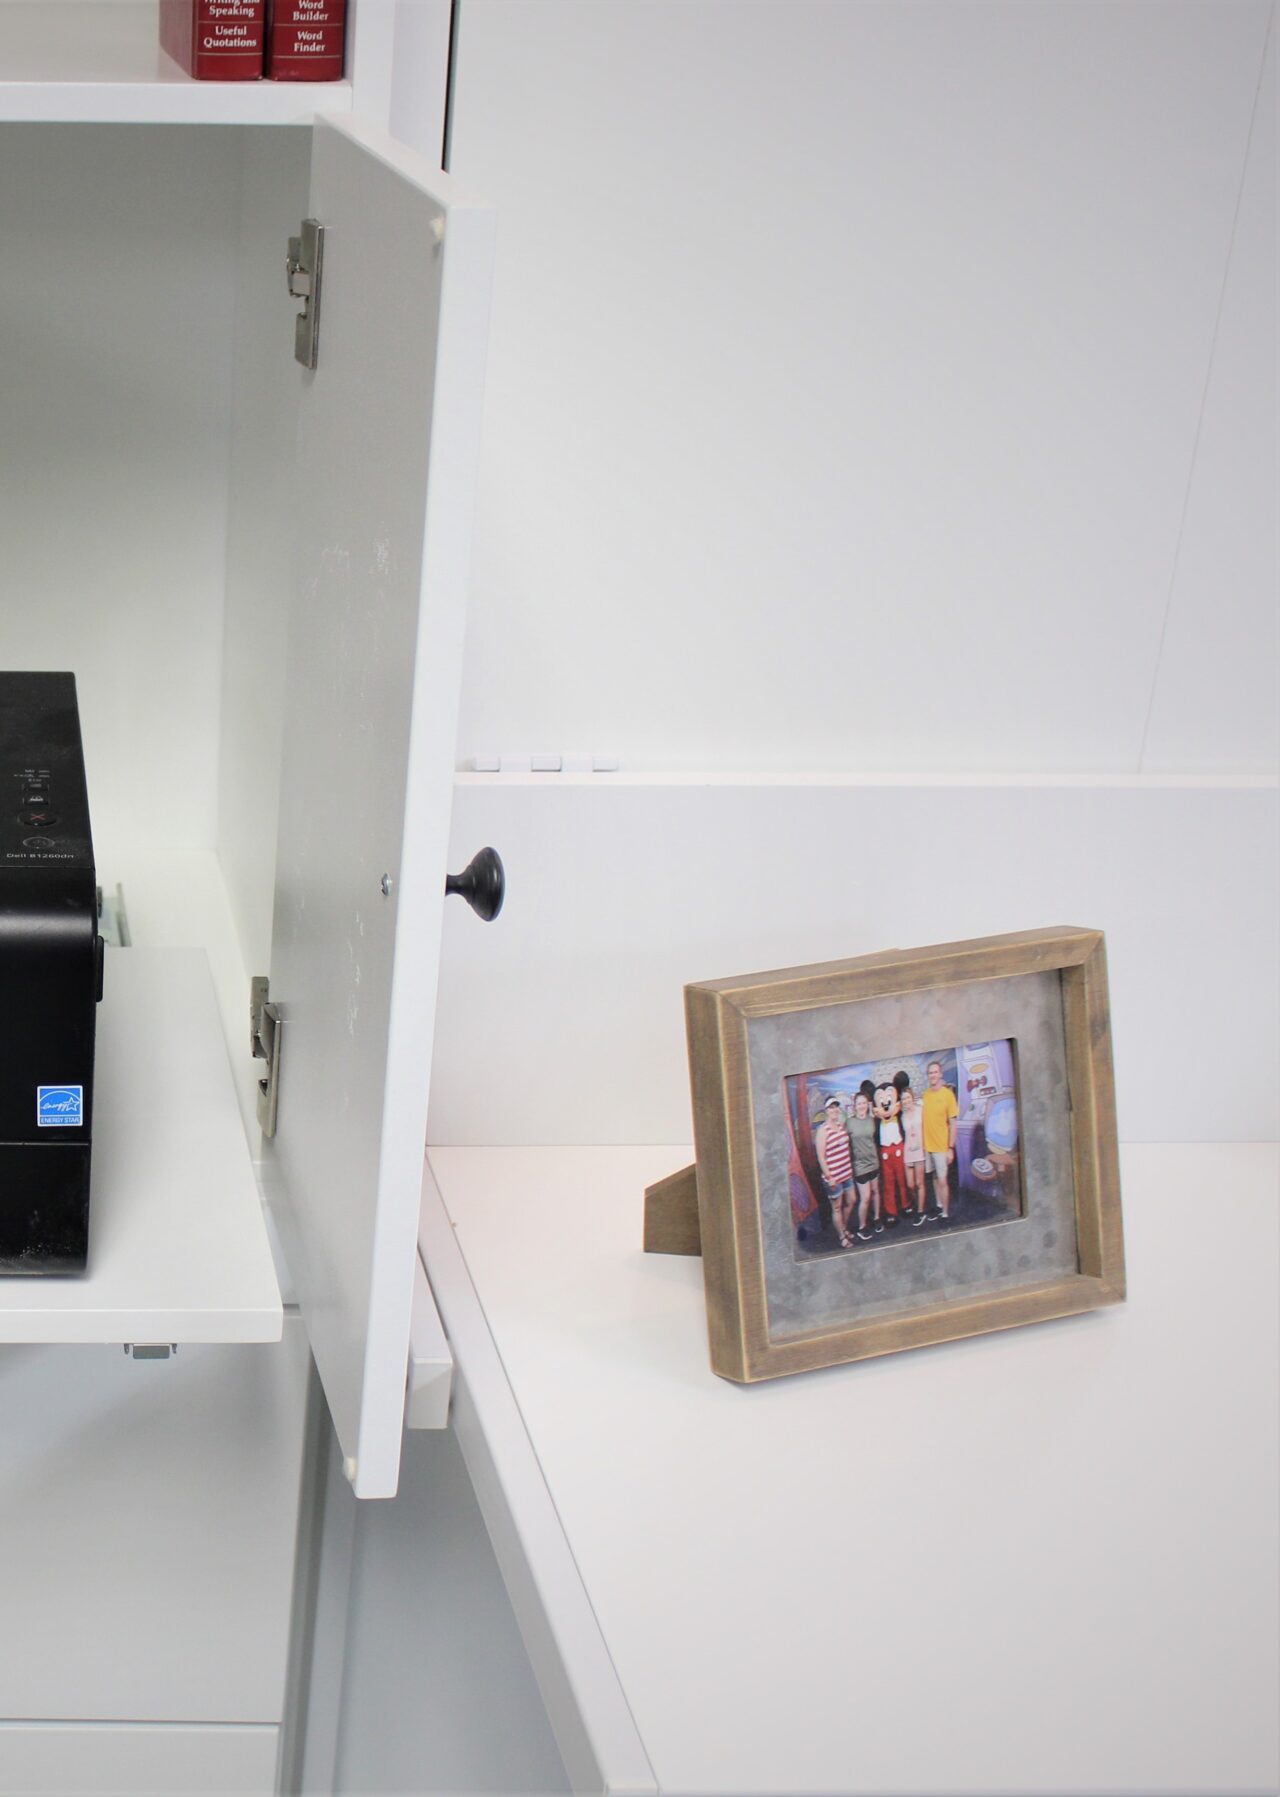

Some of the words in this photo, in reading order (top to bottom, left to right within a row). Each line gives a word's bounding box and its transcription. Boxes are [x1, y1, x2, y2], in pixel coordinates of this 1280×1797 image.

[298, 0, 324, 9] Word
[209, 5, 255, 18] Speaking
[292, 11, 329, 21] Builder
[215, 25, 247, 36] Useful
[297, 31, 323, 40] Word
[203, 37, 257, 48] Quotations
[294, 42, 326, 52] Finder
